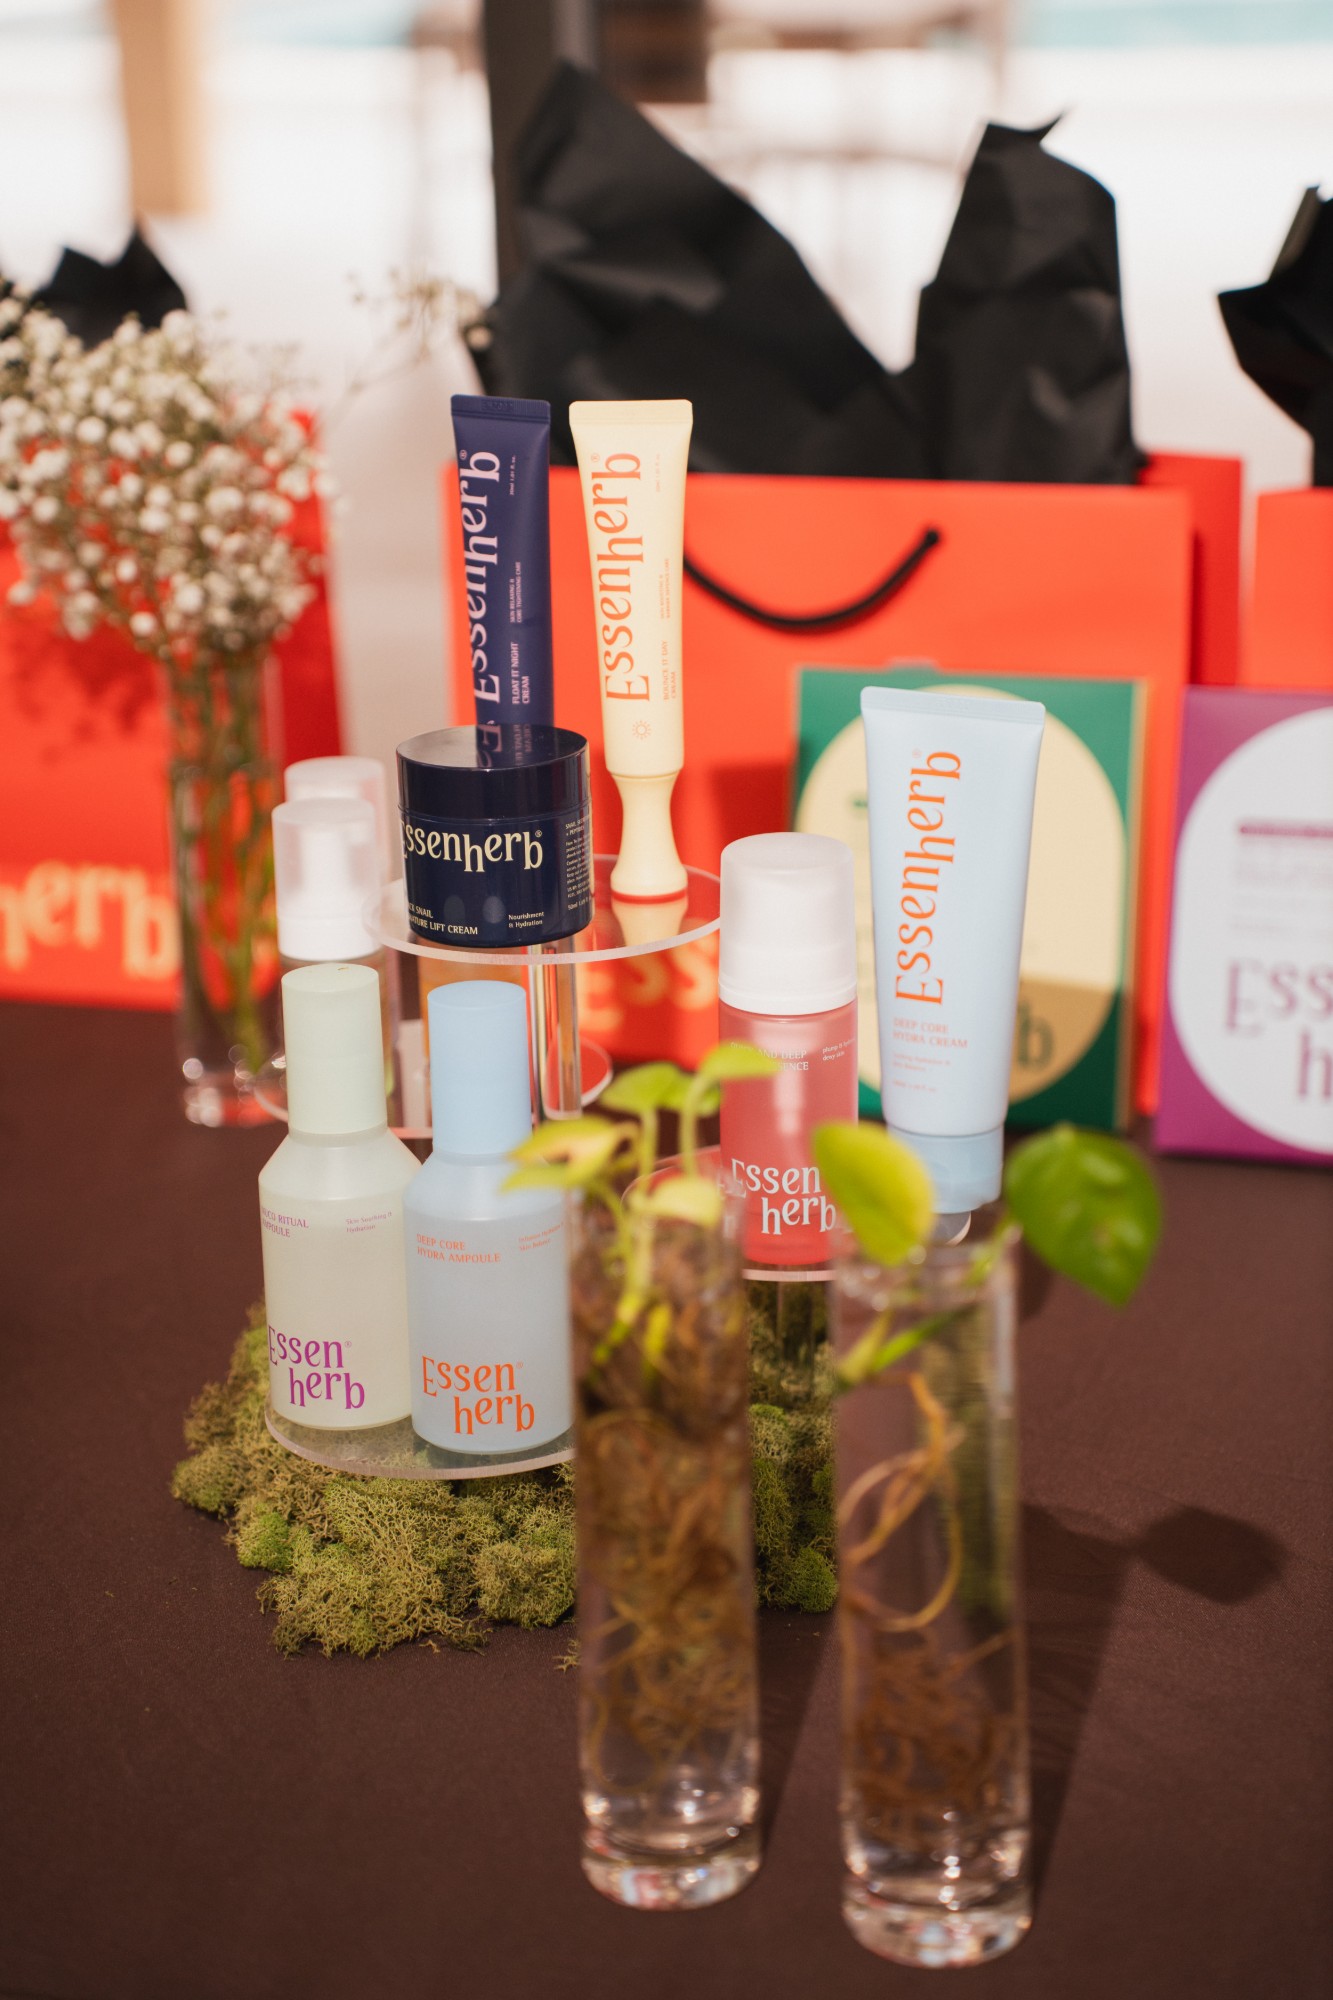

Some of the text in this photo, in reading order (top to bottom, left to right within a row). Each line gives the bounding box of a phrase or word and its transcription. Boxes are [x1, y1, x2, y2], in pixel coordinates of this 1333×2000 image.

[510, 641, 520, 704] FLOAT IT NIGHT
[521, 675, 530, 704] CREAM
[415, 905, 433, 919] SNAIL
[508, 911, 545, 920] Nourishment
[429, 921, 446, 933] LIFT
[447, 924, 478, 935] CREAM
[515, 919, 543, 929] Hydration
[893, 1016, 949, 1034] DEEP CORE
[893, 1030, 968, 1049] HYDRA CREAM
[781, 1049, 807, 1060] DEEP
[822, 1053, 836, 1061] dewy
[731, 1157, 822, 1199] Essen
[278, 1214, 310, 1229] RITUAL
[761, 1194, 837, 1236] herb
[416, 1233, 465, 1251] DEEP CORE
[416, 1246, 502, 1264] HYDRA AMPOULE
[288, 1366, 366, 1410] herb
[453, 1393, 536, 1435] herb
